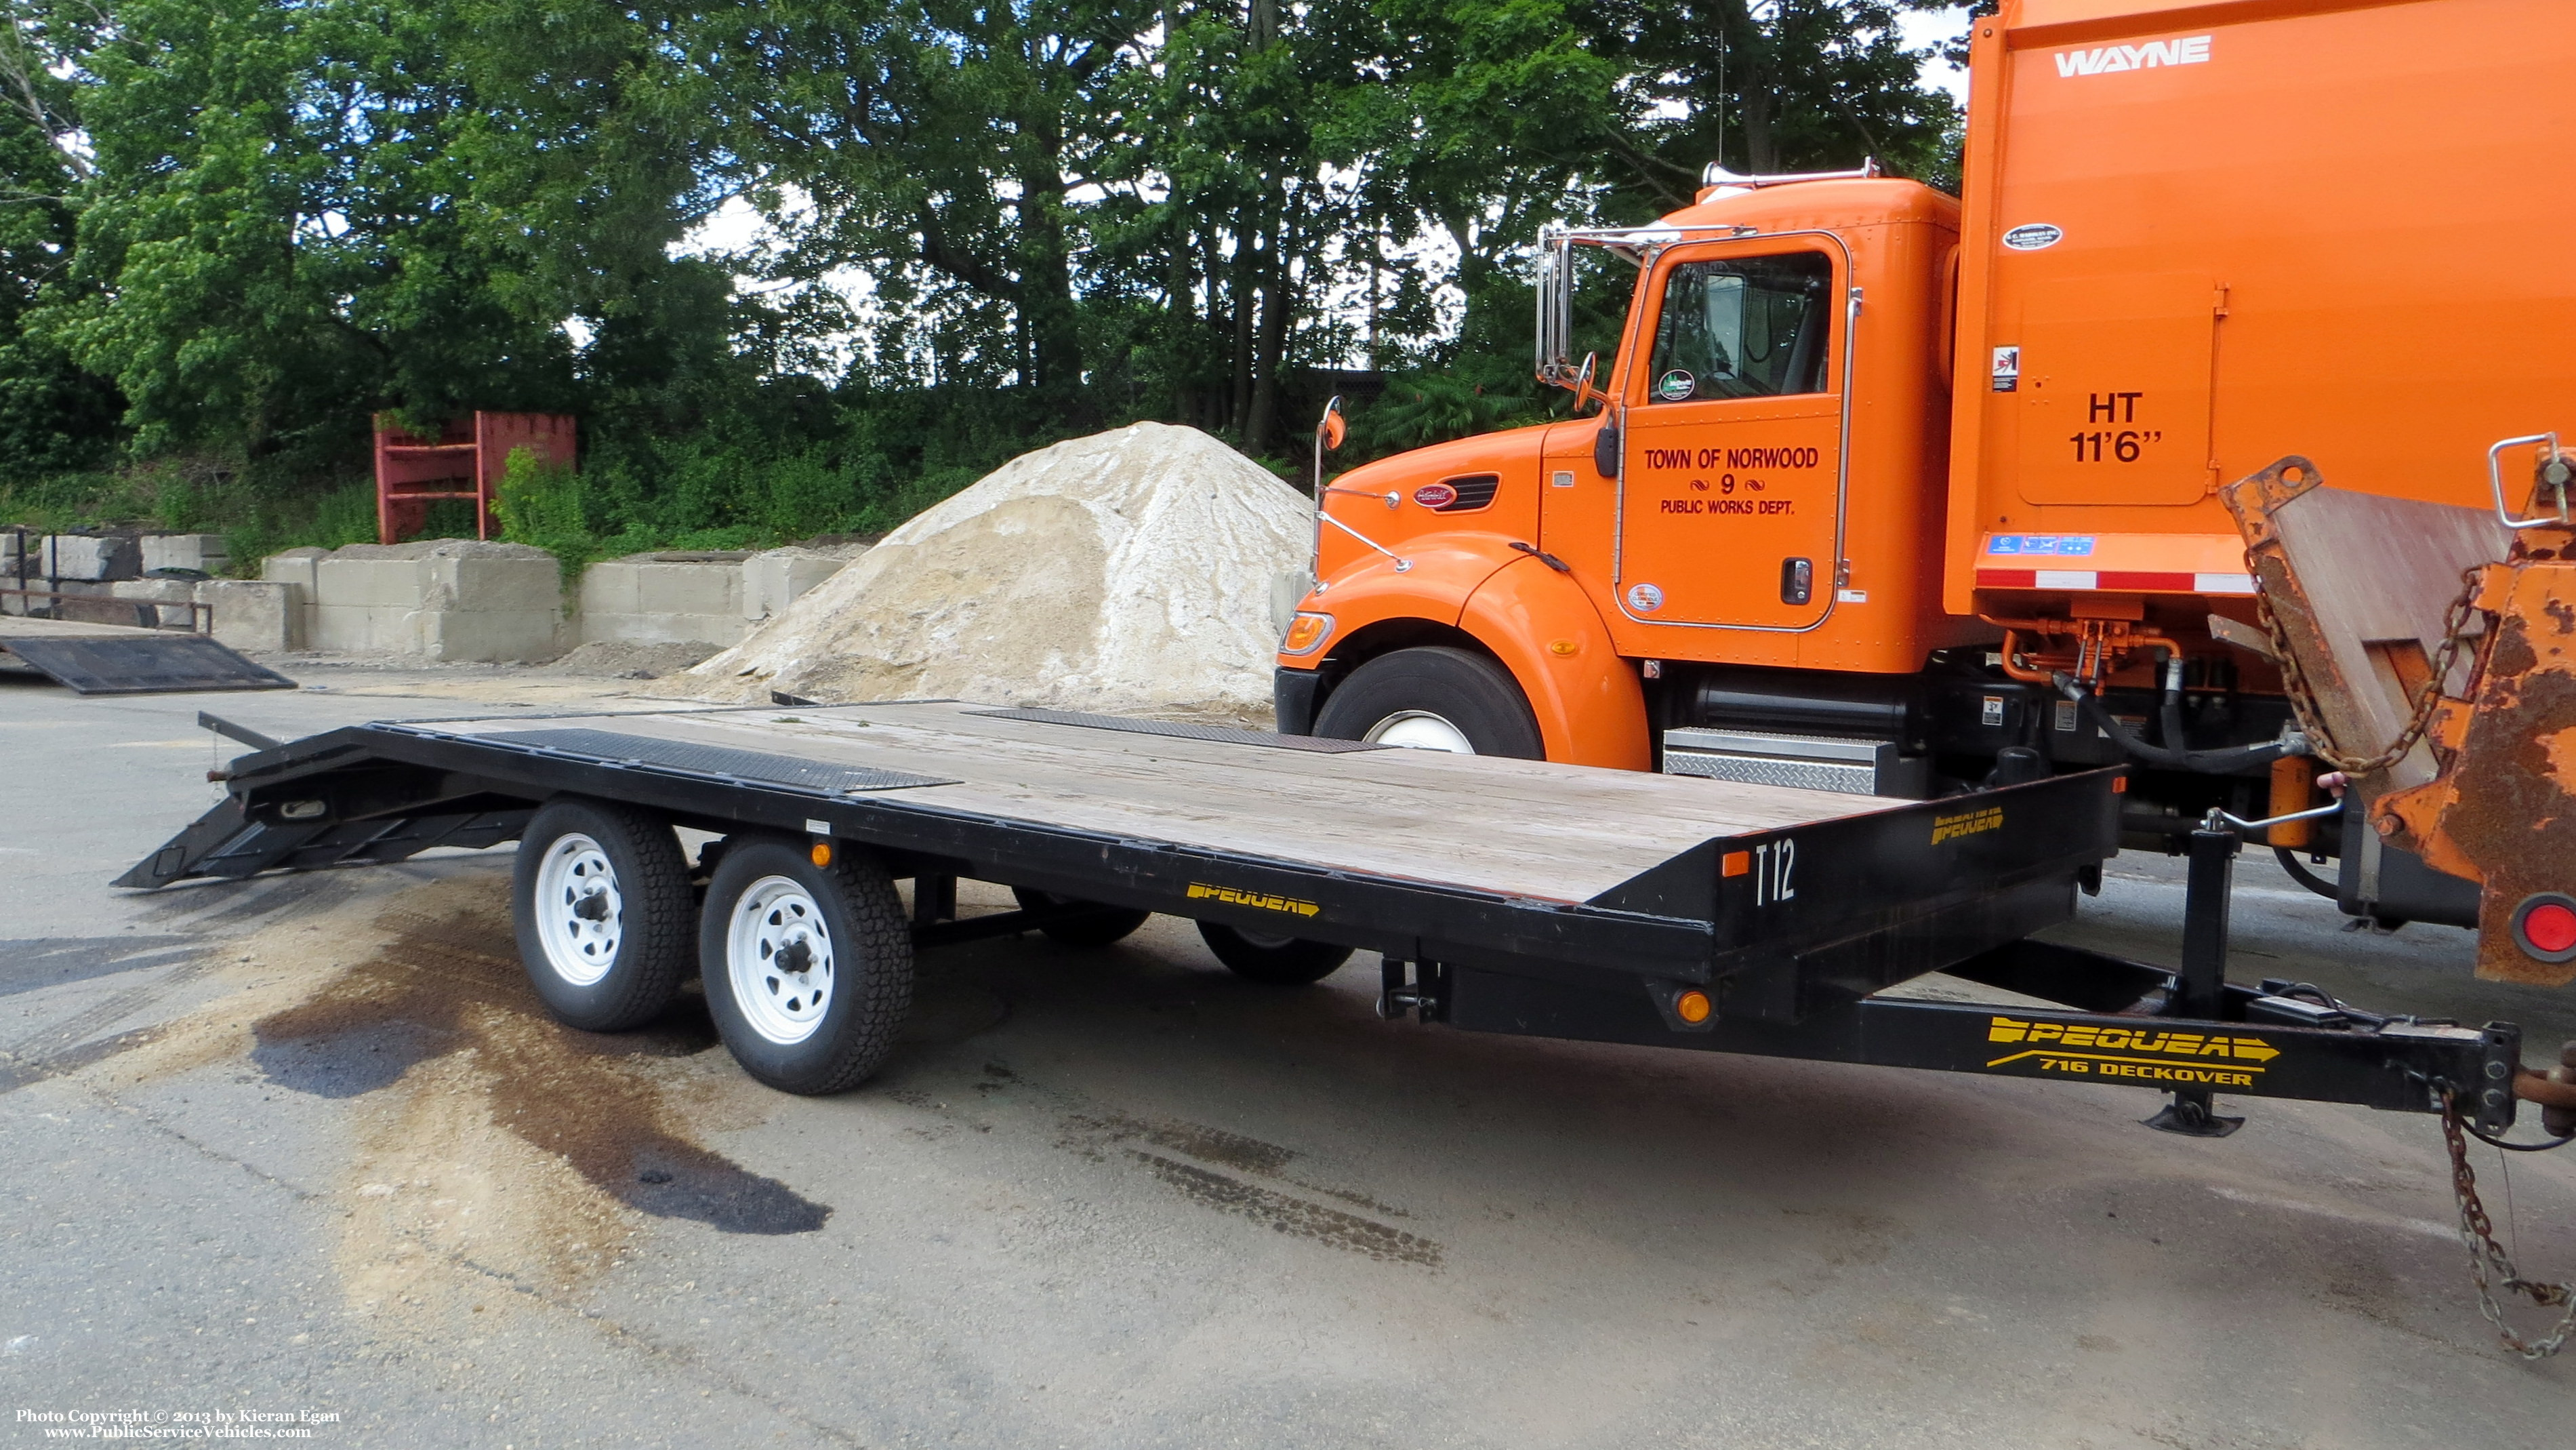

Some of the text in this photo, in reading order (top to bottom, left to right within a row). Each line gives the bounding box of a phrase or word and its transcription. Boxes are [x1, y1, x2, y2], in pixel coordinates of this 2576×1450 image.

[2054, 35, 2211, 77] WAYNE
[2089, 392, 2143, 423] HT
[1645, 447, 1818, 469] TOWN OF NORWOOD
[1721, 473, 1735, 495] 9
[1660, 500, 1795, 515] PUBLIC WORKS DEPT.
[2026, 1022, 2230, 1058] PEQUEA
[2039, 1058, 2253, 1086] 716 DECKOVER
